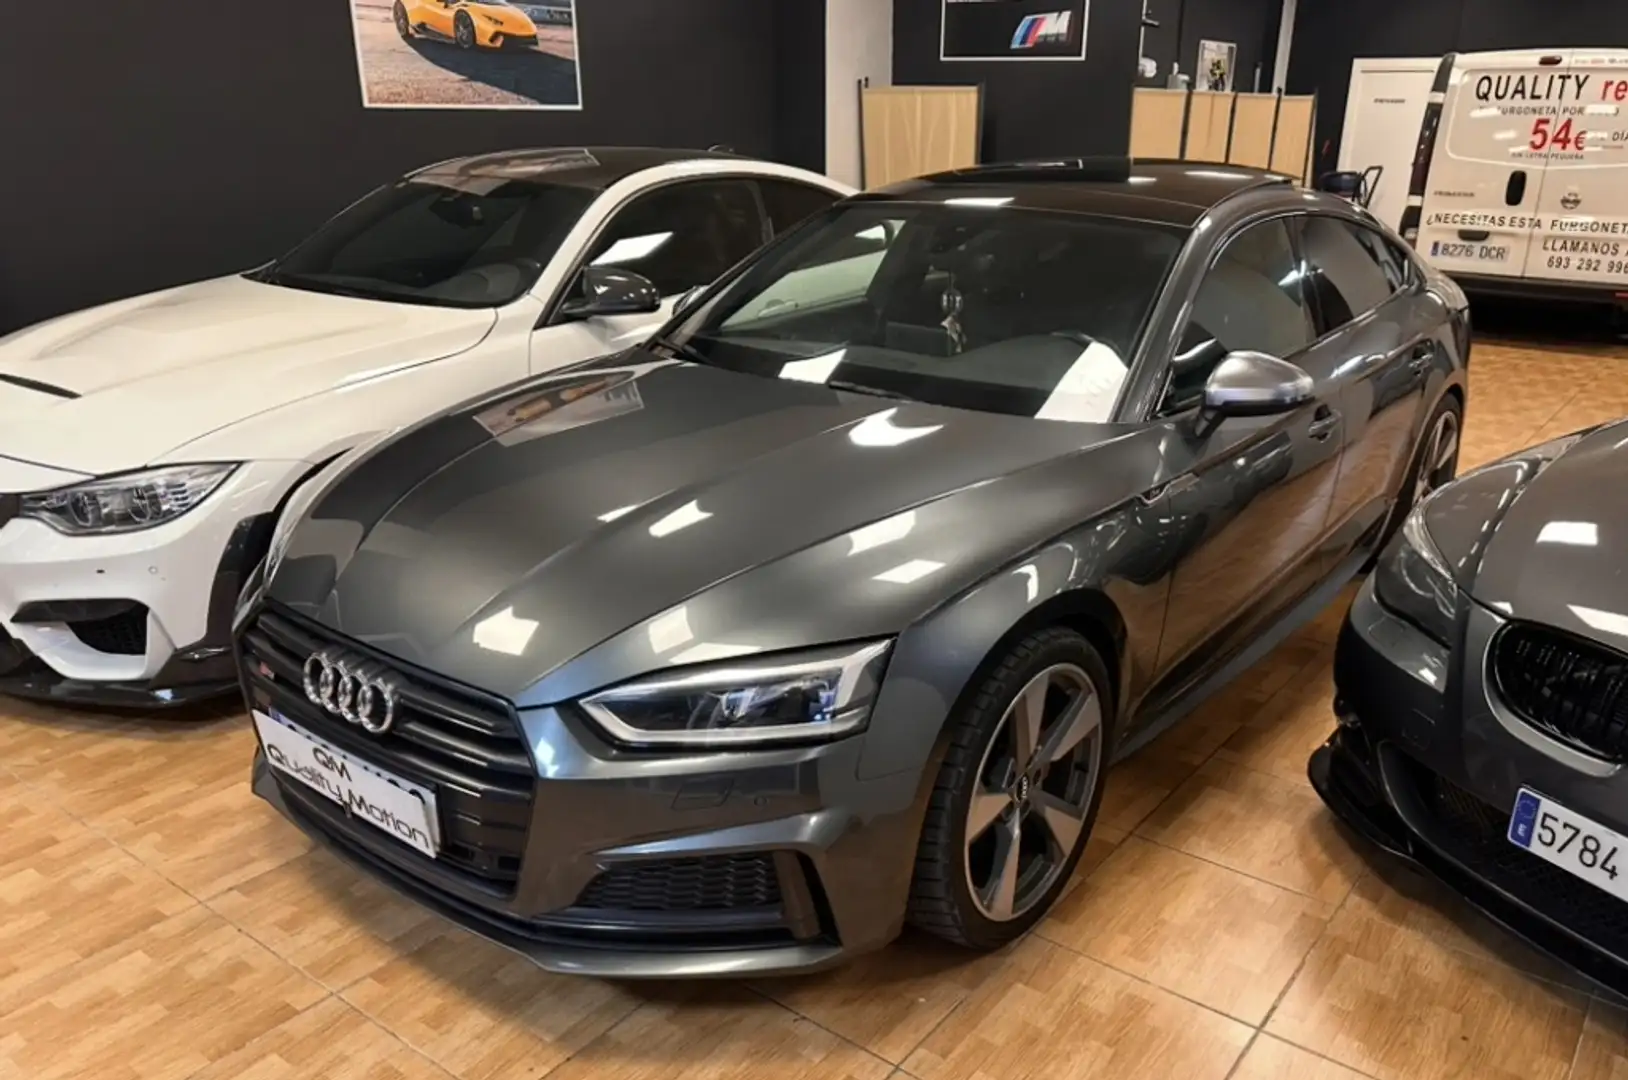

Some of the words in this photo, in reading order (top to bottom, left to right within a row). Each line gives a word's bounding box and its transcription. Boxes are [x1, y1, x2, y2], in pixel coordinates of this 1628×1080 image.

[1475, 74, 1590, 102] QUALITY
[1495, 105, 1556, 117] URGONETA
[1561, 106, 1586, 117] POR
[1529, 117, 1588, 151] 54€
[1426, 212, 1506, 228] ¿NECESITAS
[1508, 216, 1542, 229] ESTA
[1550, 219, 1628, 236] FURGONET
[1441, 243, 1475, 258] 8276
[1479, 245, 1506, 260] DCR
[1542, 239, 1620, 257] LLAMANOS
[1547, 255, 1571, 269] 693
[1576, 257, 1601, 272] 292
[347, 788, 430, 850] Motion
[1538, 811, 1618, 881] 5784
